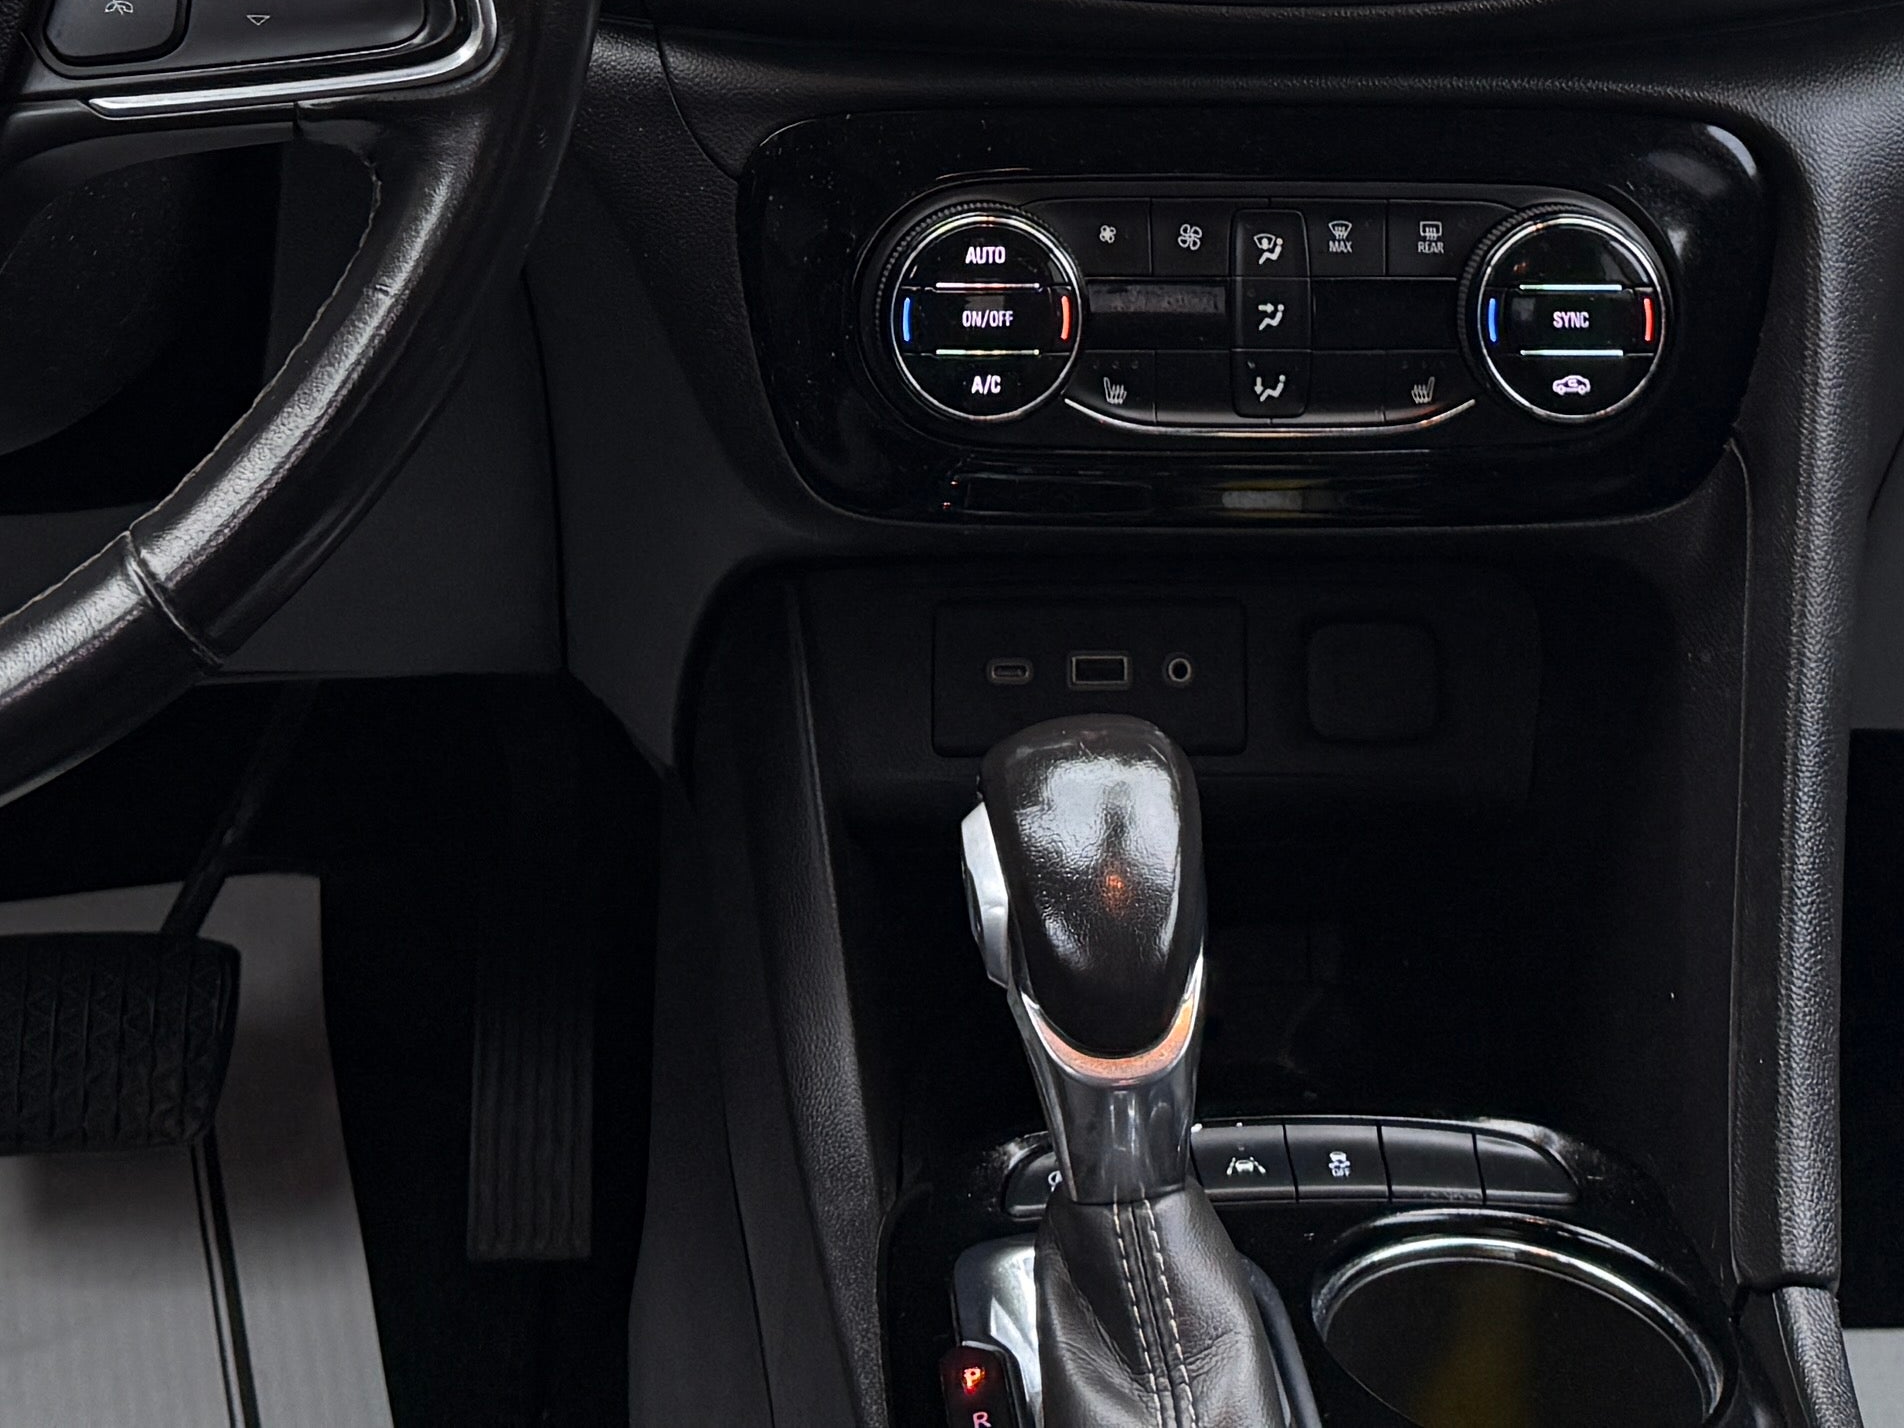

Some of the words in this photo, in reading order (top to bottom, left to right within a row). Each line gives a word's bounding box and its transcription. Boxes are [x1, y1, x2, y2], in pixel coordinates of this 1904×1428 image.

[965, 246, 1006, 264] AUTO
[1328, 241, 1353, 254] MAX
[1417, 241, 1444, 254] REAR
[962, 310, 1014, 329] ON/OFF
[1552, 311, 1590, 329] SYNC
[971, 374, 1002, 395] A/C
[963, 1366, 985, 1394] P
[973, 1411, 992, 1428] R
